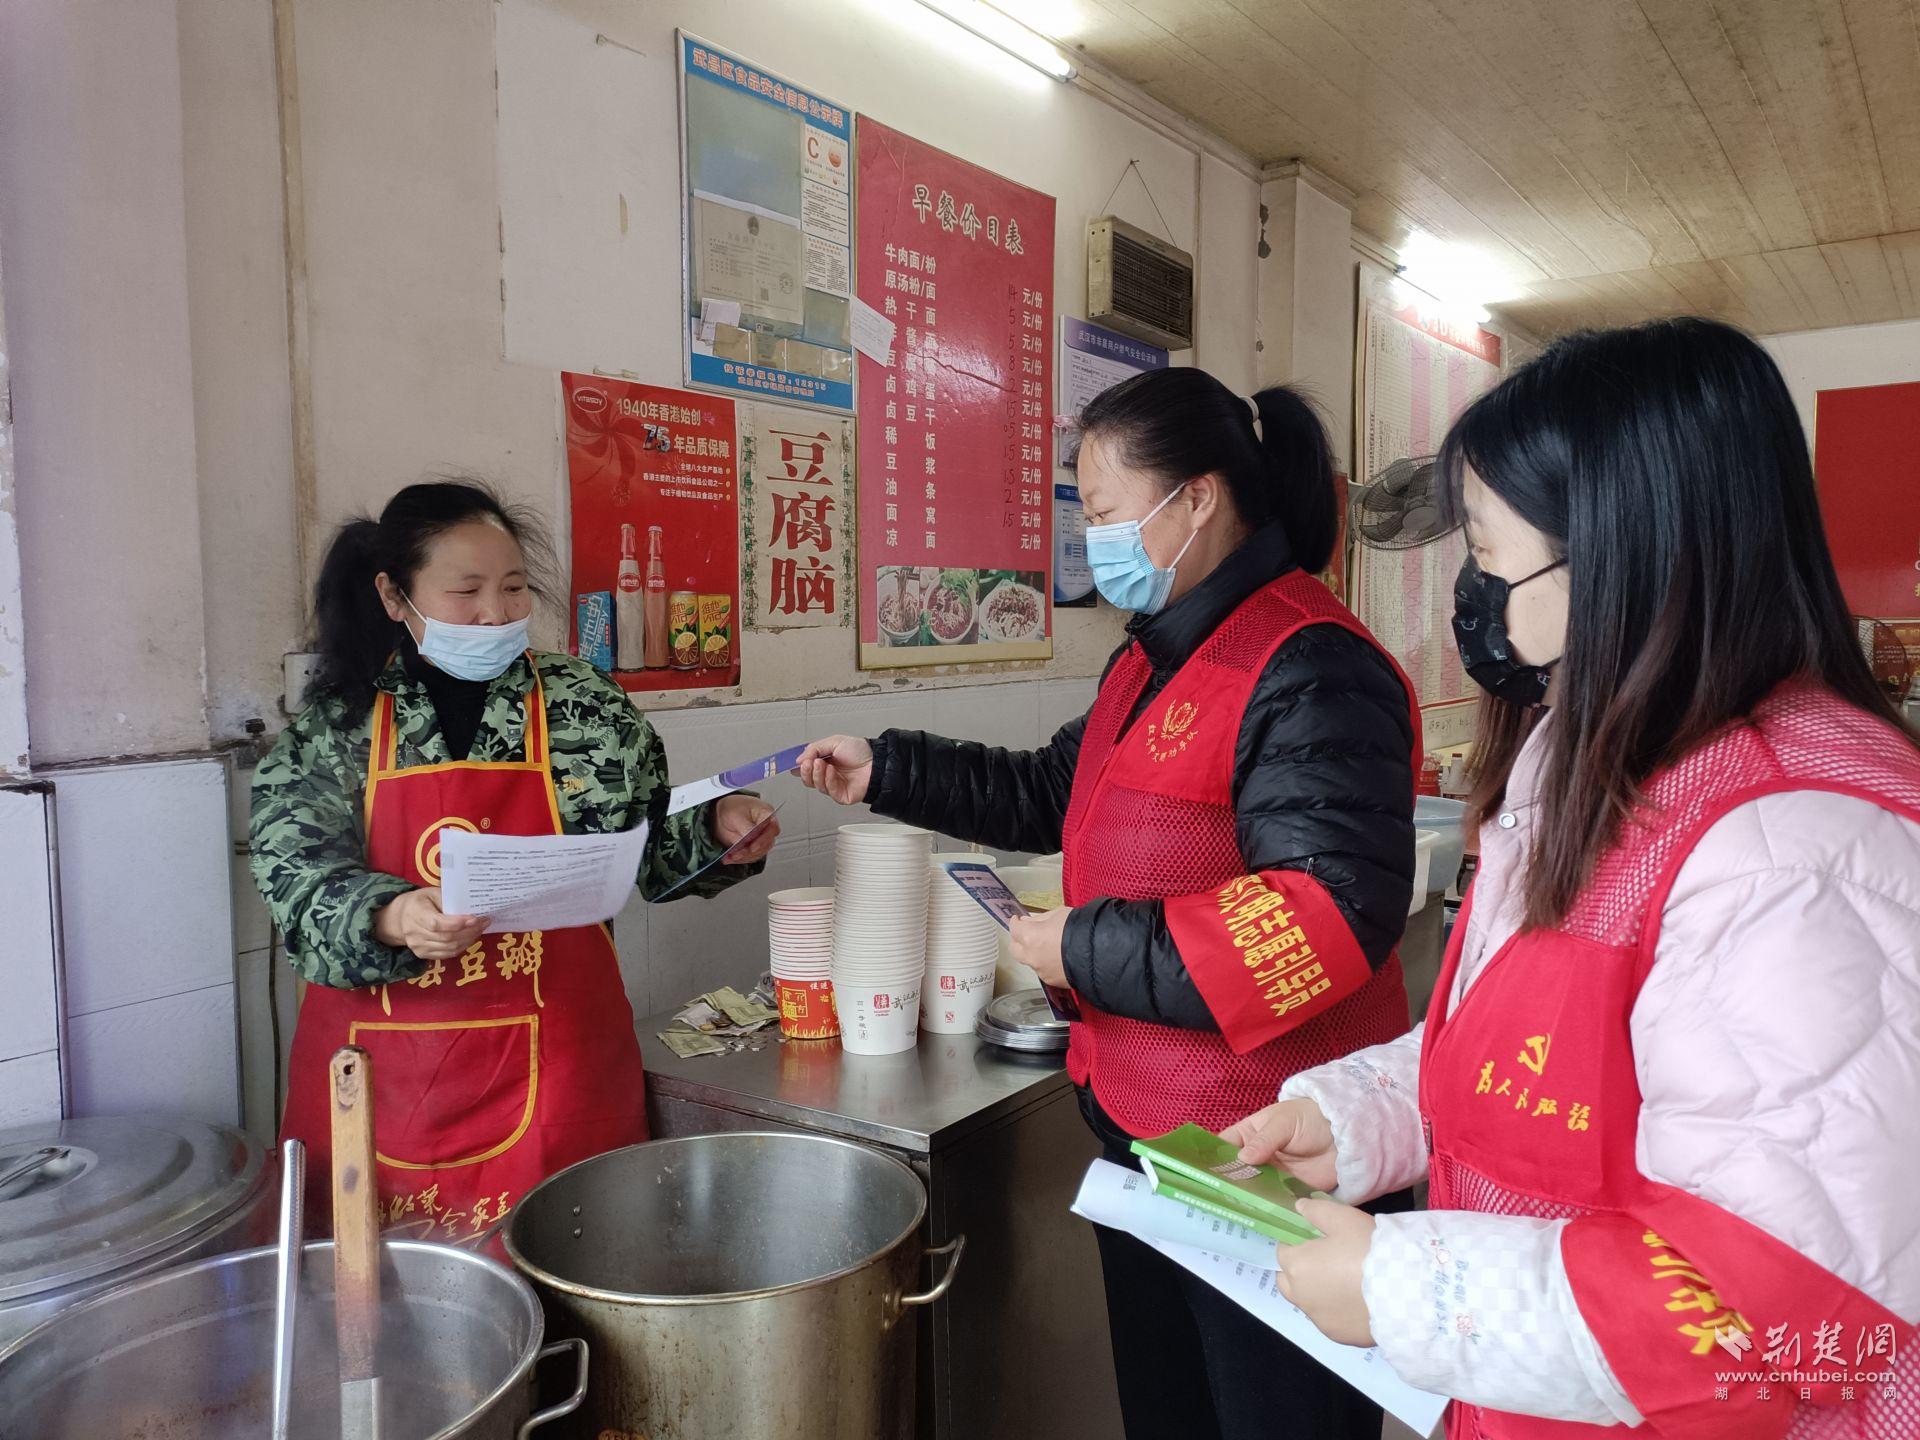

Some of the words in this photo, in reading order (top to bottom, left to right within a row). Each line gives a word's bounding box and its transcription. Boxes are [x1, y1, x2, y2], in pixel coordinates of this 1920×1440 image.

[692, 47, 844, 129] 武昌区食品安全信息公示牌
[912, 183, 1024, 255] 早餐价目表
[885, 243, 936, 275] 牛肉面/粉
[1022, 287, 1043, 309] 元/份
[885, 269, 936, 300] 原汤粉/面
[1022, 310, 1042, 332] 元/份
[885, 295, 936, 326] 热干面
[1022, 333, 1042, 354] 元/份
[1021, 356, 1042, 377] 元/份
[885, 373, 936, 400] 卤鸡蛋
[1021, 399, 1042, 418] 元/份
[1021, 379, 1042, 398] 元/份
[616, 398, 701, 427] 1940年香港始创
[885, 399, 936, 426] 卤豆干
[1021, 422, 1042, 441] 元/份
[642, 423, 671, 452] 75
[674, 434, 730, 459] 年品质保障
[885, 425, 936, 451] 稀饭
[1021, 444, 1042, 463] 元/份
[885, 451, 936, 475] 豆浆
[1021, 466, 1041, 485] 元/份
[885, 477, 936, 500] 油条
[1020, 489, 1041, 507] 元/份
[766, 428, 836, 615] 豆腐脑
[885, 503, 936, 525] 面窝
[1020, 511, 1041, 529] 元/份
[1020, 533, 1041, 551] 元/份
